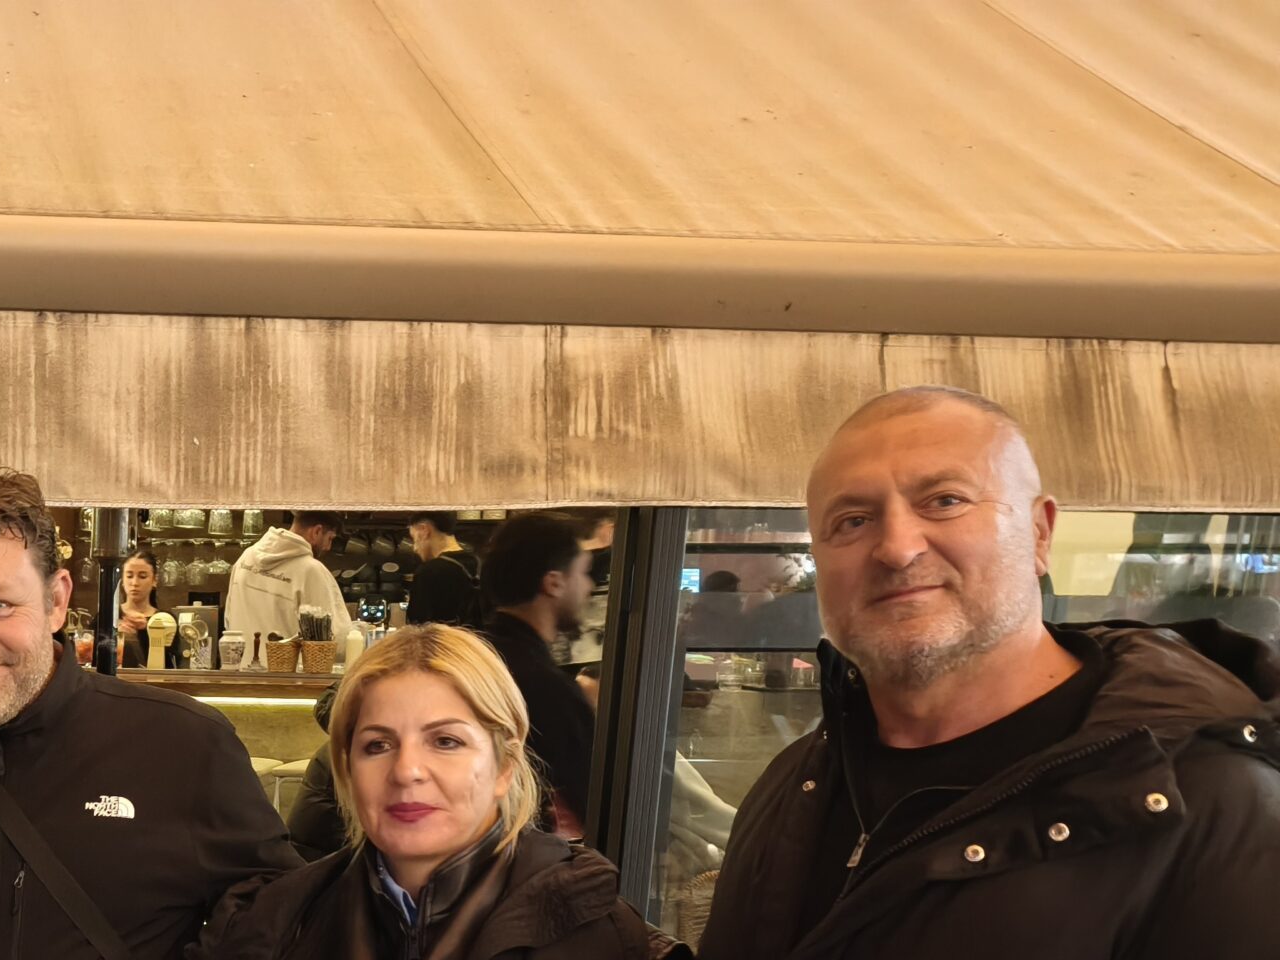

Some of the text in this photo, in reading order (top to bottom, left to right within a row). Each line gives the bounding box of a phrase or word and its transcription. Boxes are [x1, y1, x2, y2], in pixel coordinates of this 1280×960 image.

[99, 795, 119, 803] THE
[85, 802, 119, 811] NORTH
[93, 809, 119, 817] FACE
